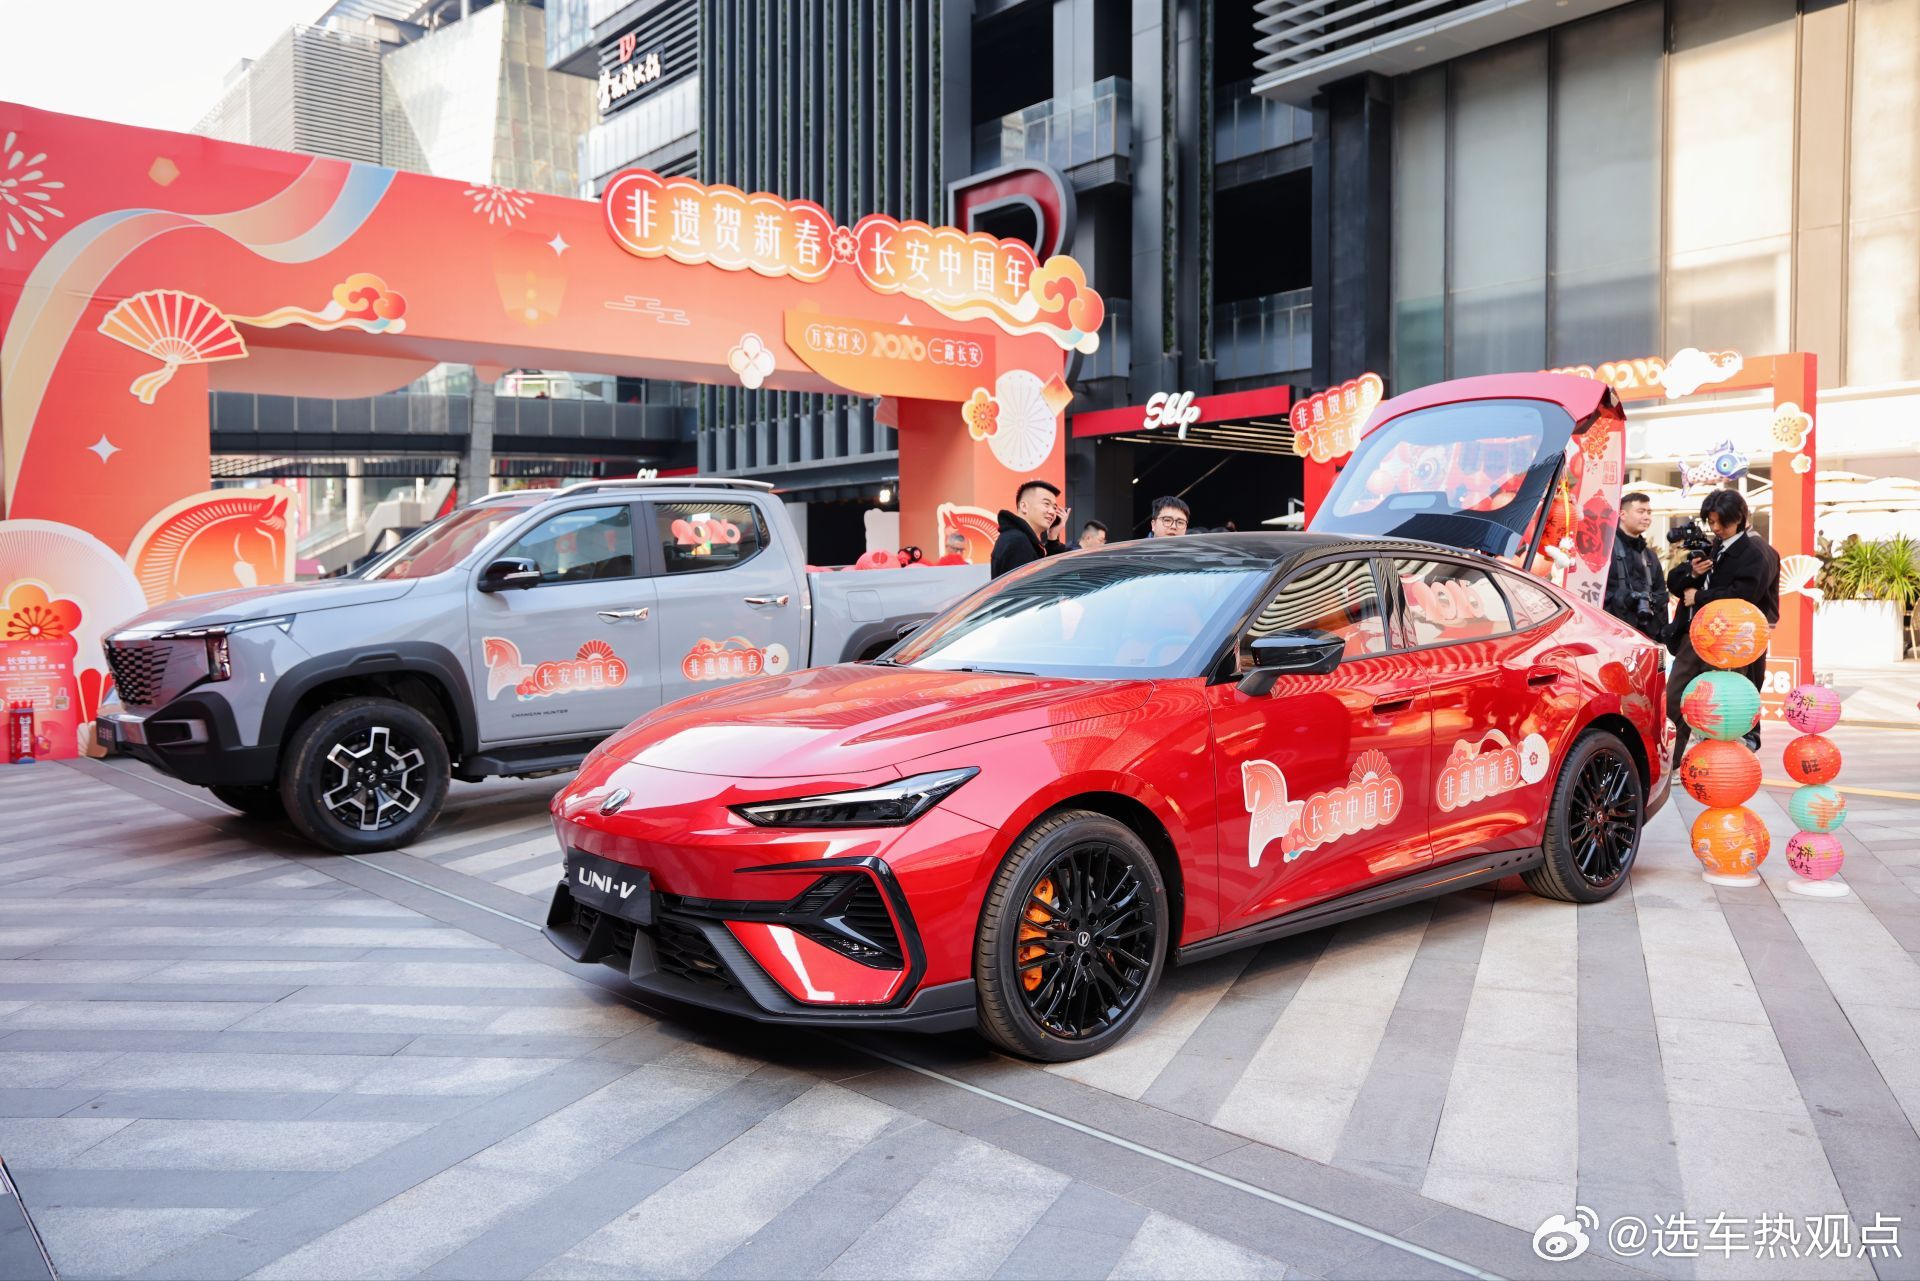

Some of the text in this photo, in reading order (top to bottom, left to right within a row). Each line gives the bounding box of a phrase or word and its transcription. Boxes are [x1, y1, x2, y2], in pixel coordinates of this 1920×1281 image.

[625, 188, 822, 267] 非遗贺新春
[869, 231, 1027, 298] 长安中国年
[811, 328, 862, 352] 万家灯火
[871, 331, 926, 362] 2026
[932, 343, 980, 363] 一路长安
[1296, 381, 1375, 429] 非遗贺新春
[671, 518, 741, 545] 2026
[541, 664, 619, 687] 长安中国年
[689, 654, 758, 676] 非遗贺新春
[1443, 756, 1514, 802] 非遗贺新春
[1310, 786, 1395, 834] 长安中国年
[578, 866, 637, 899] UNI-V
